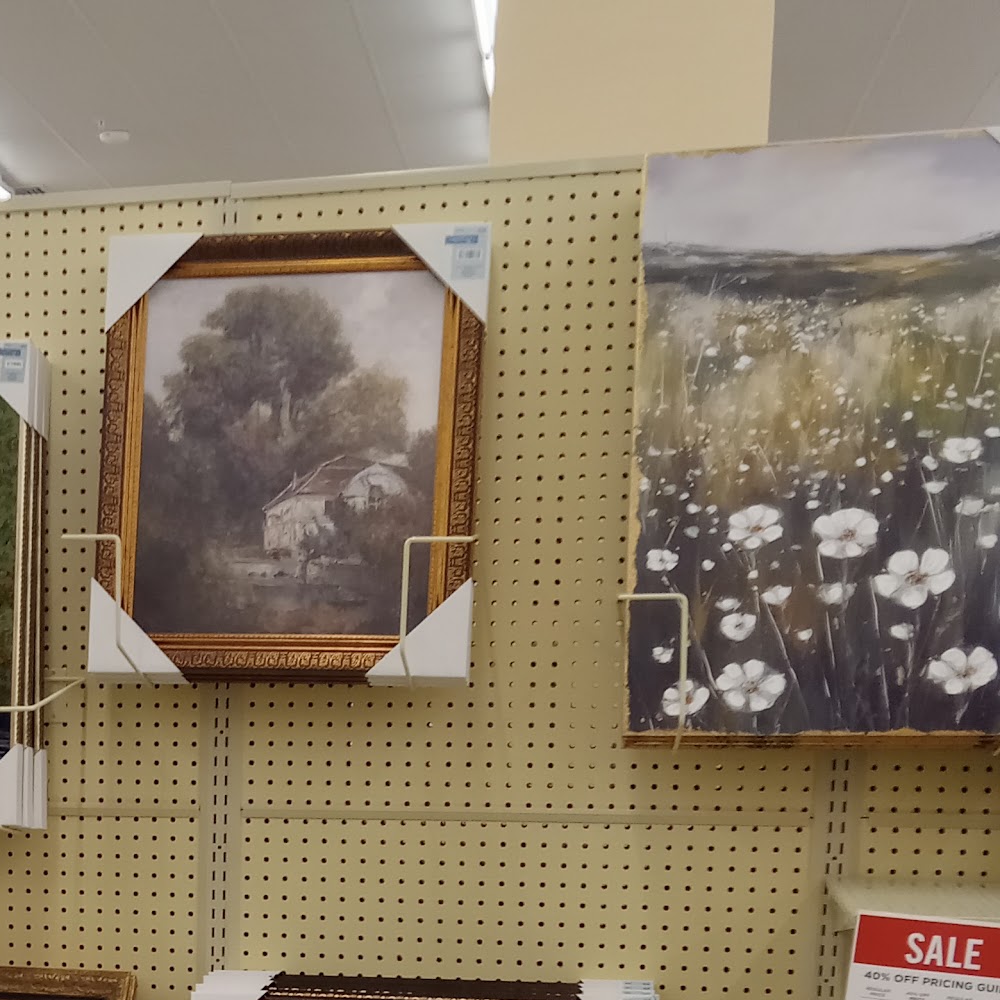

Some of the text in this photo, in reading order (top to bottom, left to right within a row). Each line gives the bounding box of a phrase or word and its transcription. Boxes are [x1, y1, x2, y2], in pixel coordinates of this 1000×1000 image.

[904, 932, 984, 970] SALE
[864, 971, 1000, 994] 40% OFF PRICING GUI
